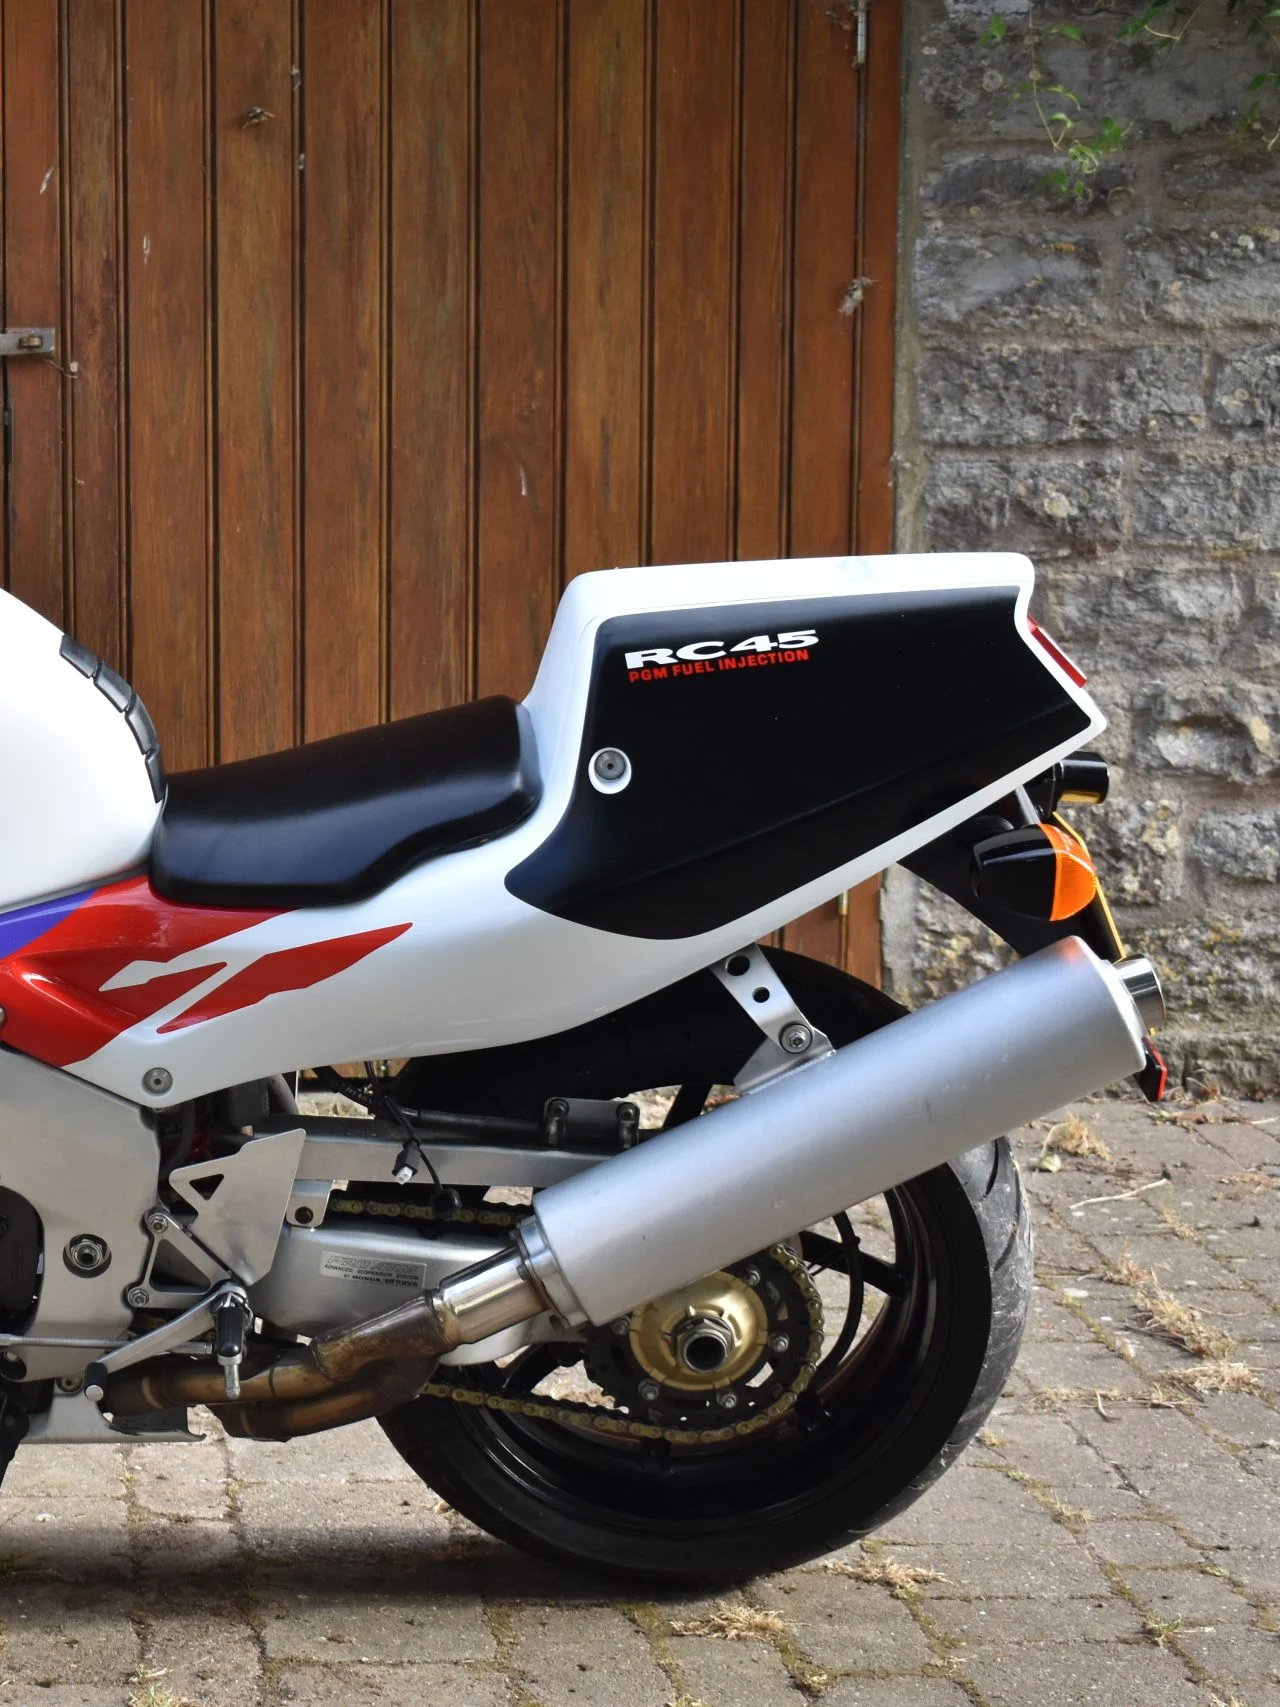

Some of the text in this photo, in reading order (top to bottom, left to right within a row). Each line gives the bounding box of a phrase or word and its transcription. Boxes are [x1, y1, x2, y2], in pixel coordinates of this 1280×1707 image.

[628, 649, 810, 684] PGM FUEL INJECTION
[324, 1263, 353, 1273] ADVANCED
[357, 1269, 393, 1278] SUSPENSION
